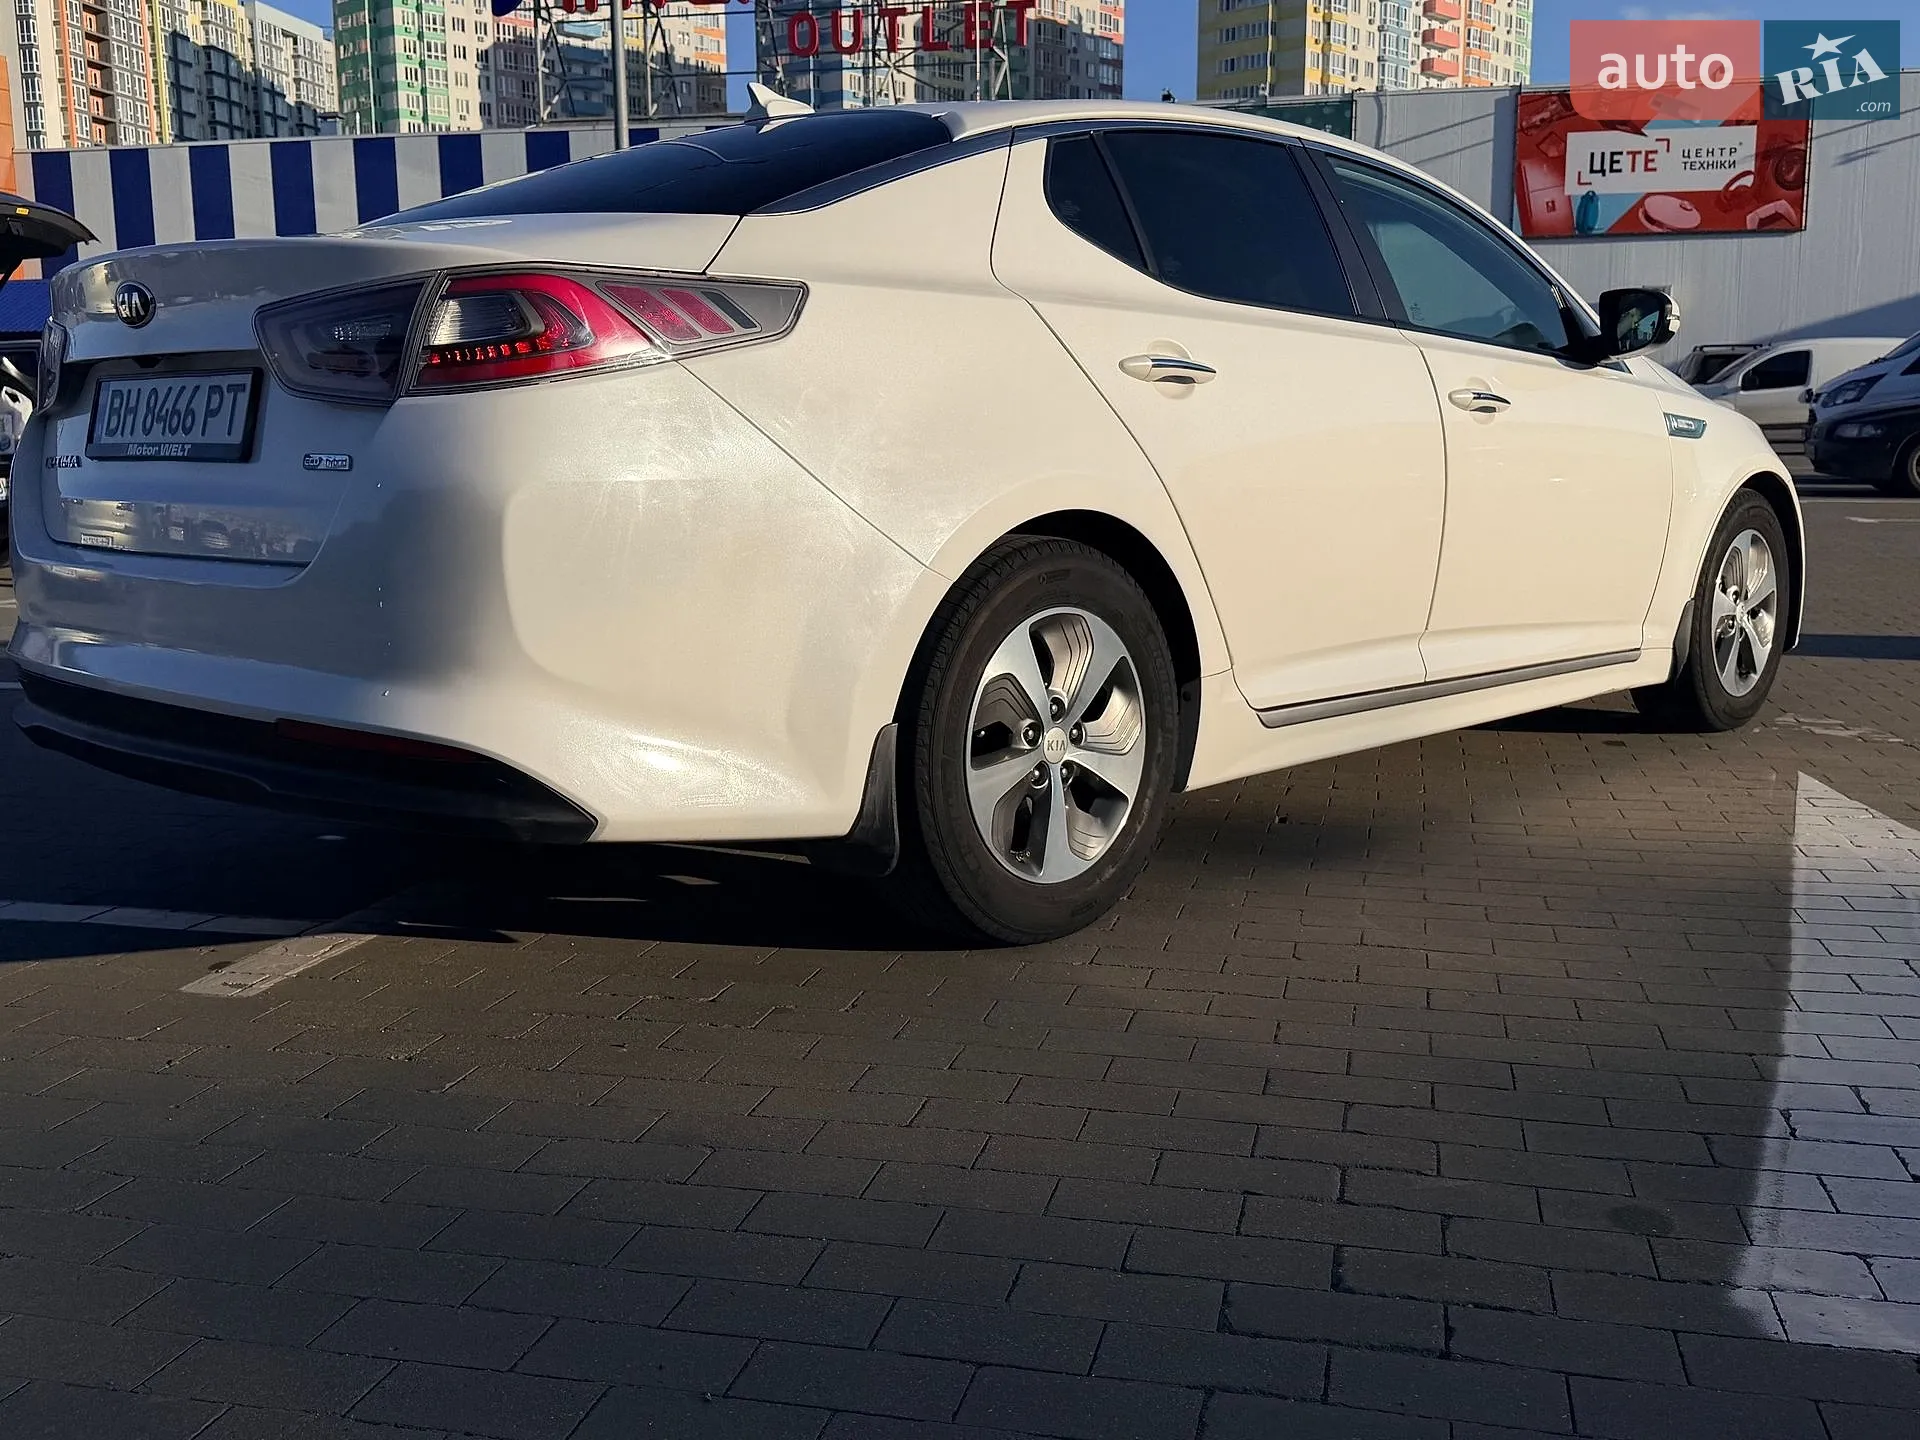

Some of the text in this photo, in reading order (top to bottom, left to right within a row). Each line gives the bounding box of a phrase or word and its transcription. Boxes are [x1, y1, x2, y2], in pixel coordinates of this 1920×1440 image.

[788, 0, 1035, 57] OUTLET
[1682, 147, 1738, 159] ЦЕНТР
[1589, 150, 1658, 177] ЦЕТЕ
[1682, 160, 1736, 171] ТЕХНІКИ
[119, 292, 145, 318] KIA
[105, 383, 246, 438] BH 8466 PT
[127, 444, 192, 456] Motor WELT
[1047, 739, 1066, 751] KIA
